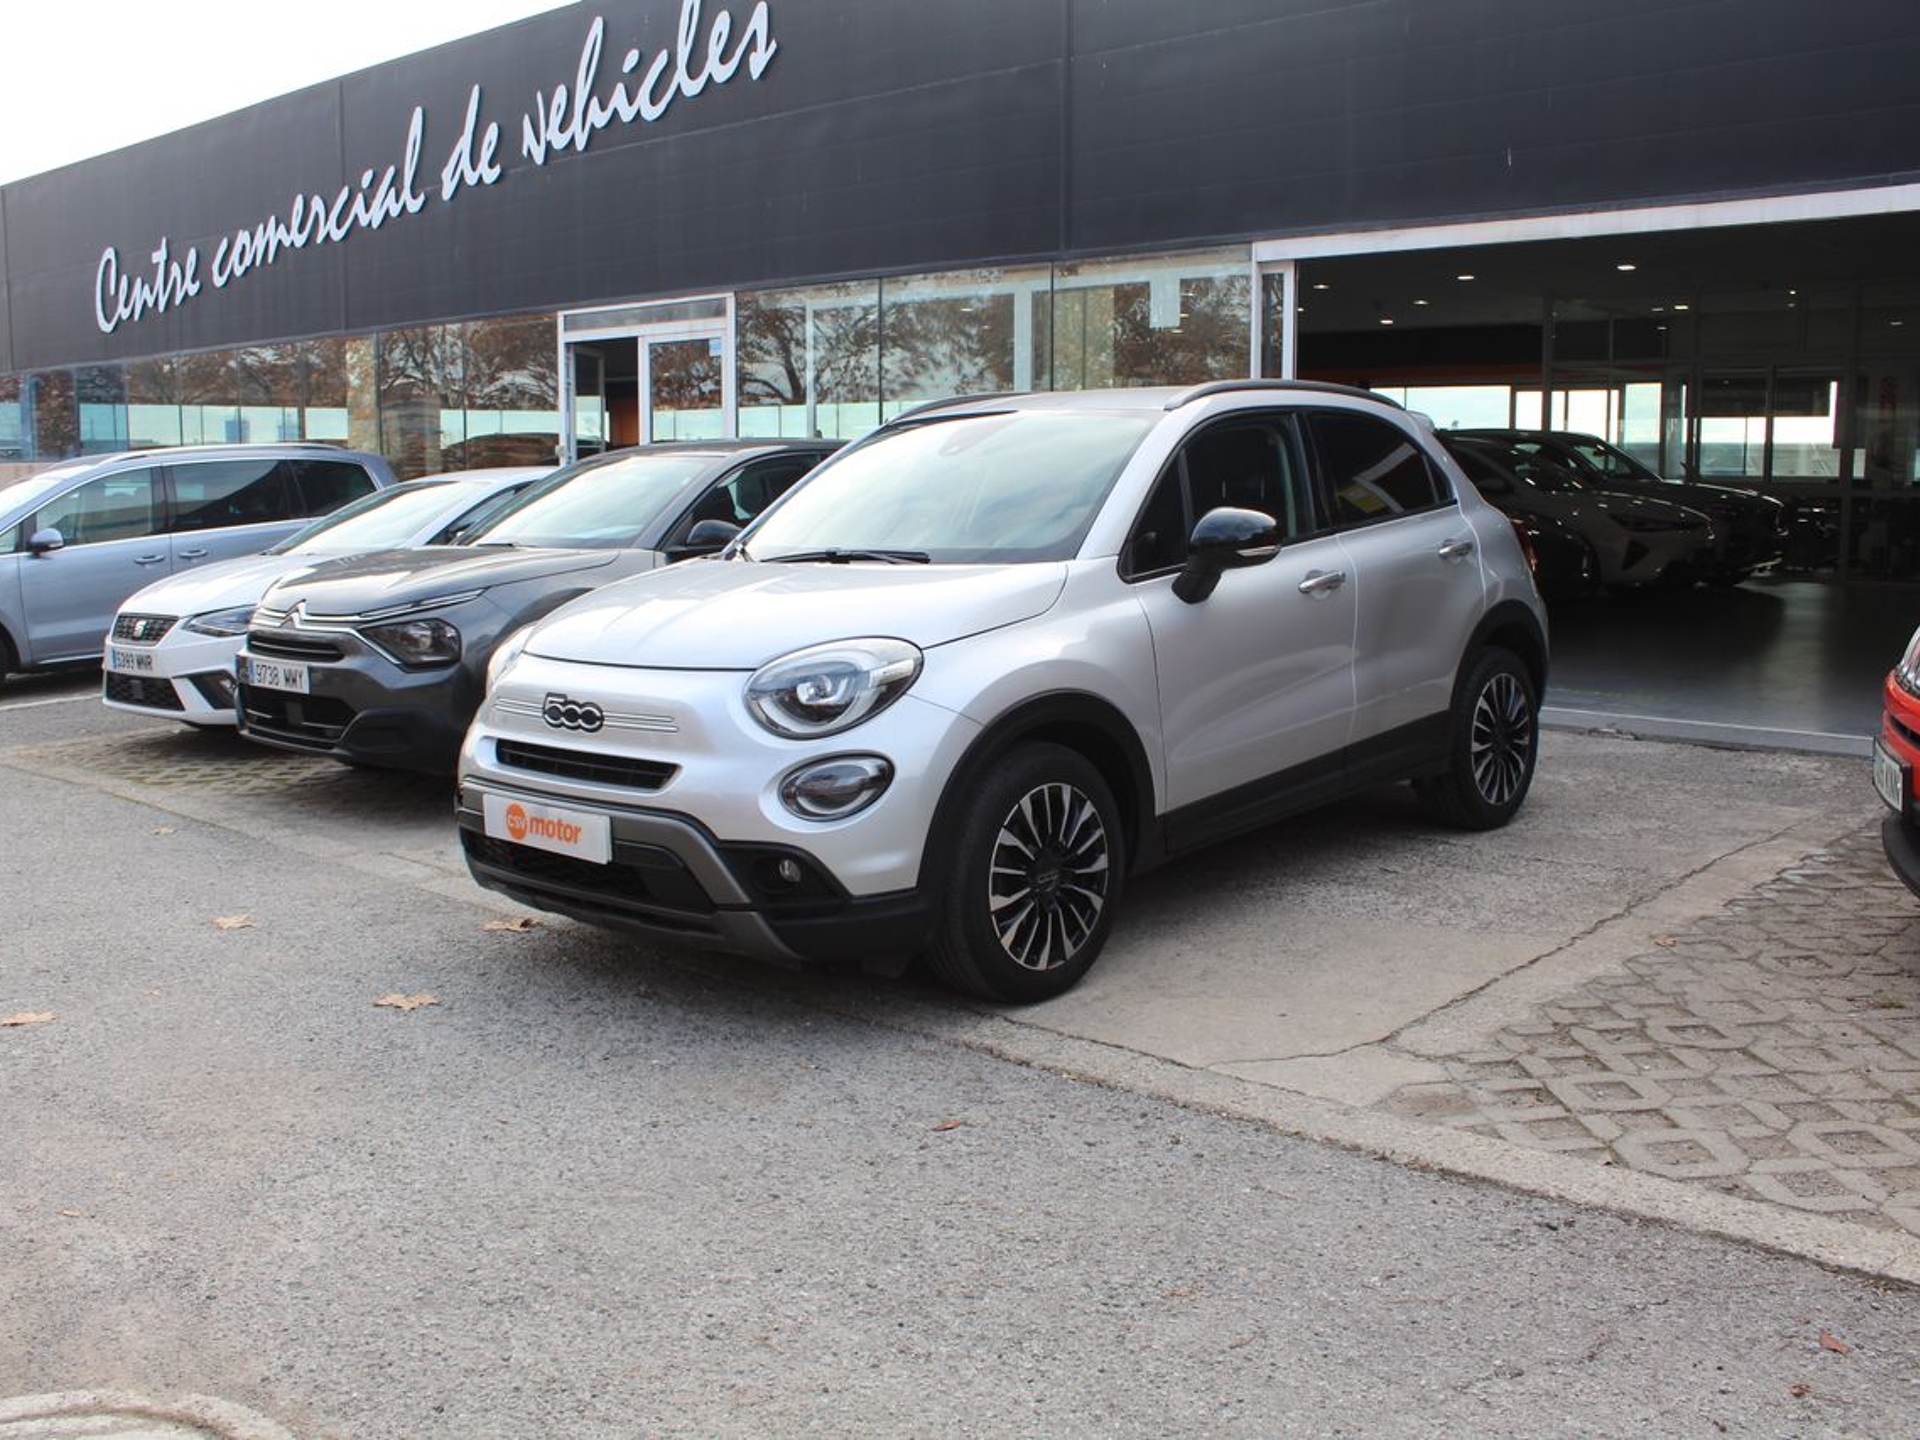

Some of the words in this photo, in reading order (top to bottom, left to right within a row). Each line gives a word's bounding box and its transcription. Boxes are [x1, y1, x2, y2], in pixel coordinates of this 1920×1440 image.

[95, 236, 201, 333] Centre
[211, 105, 425, 288] comercial
[441, 84, 501, 201] de
[522, 0, 778, 166] vehicles
[542, 692, 605, 733] 500
[529, 816, 582, 844] motor
